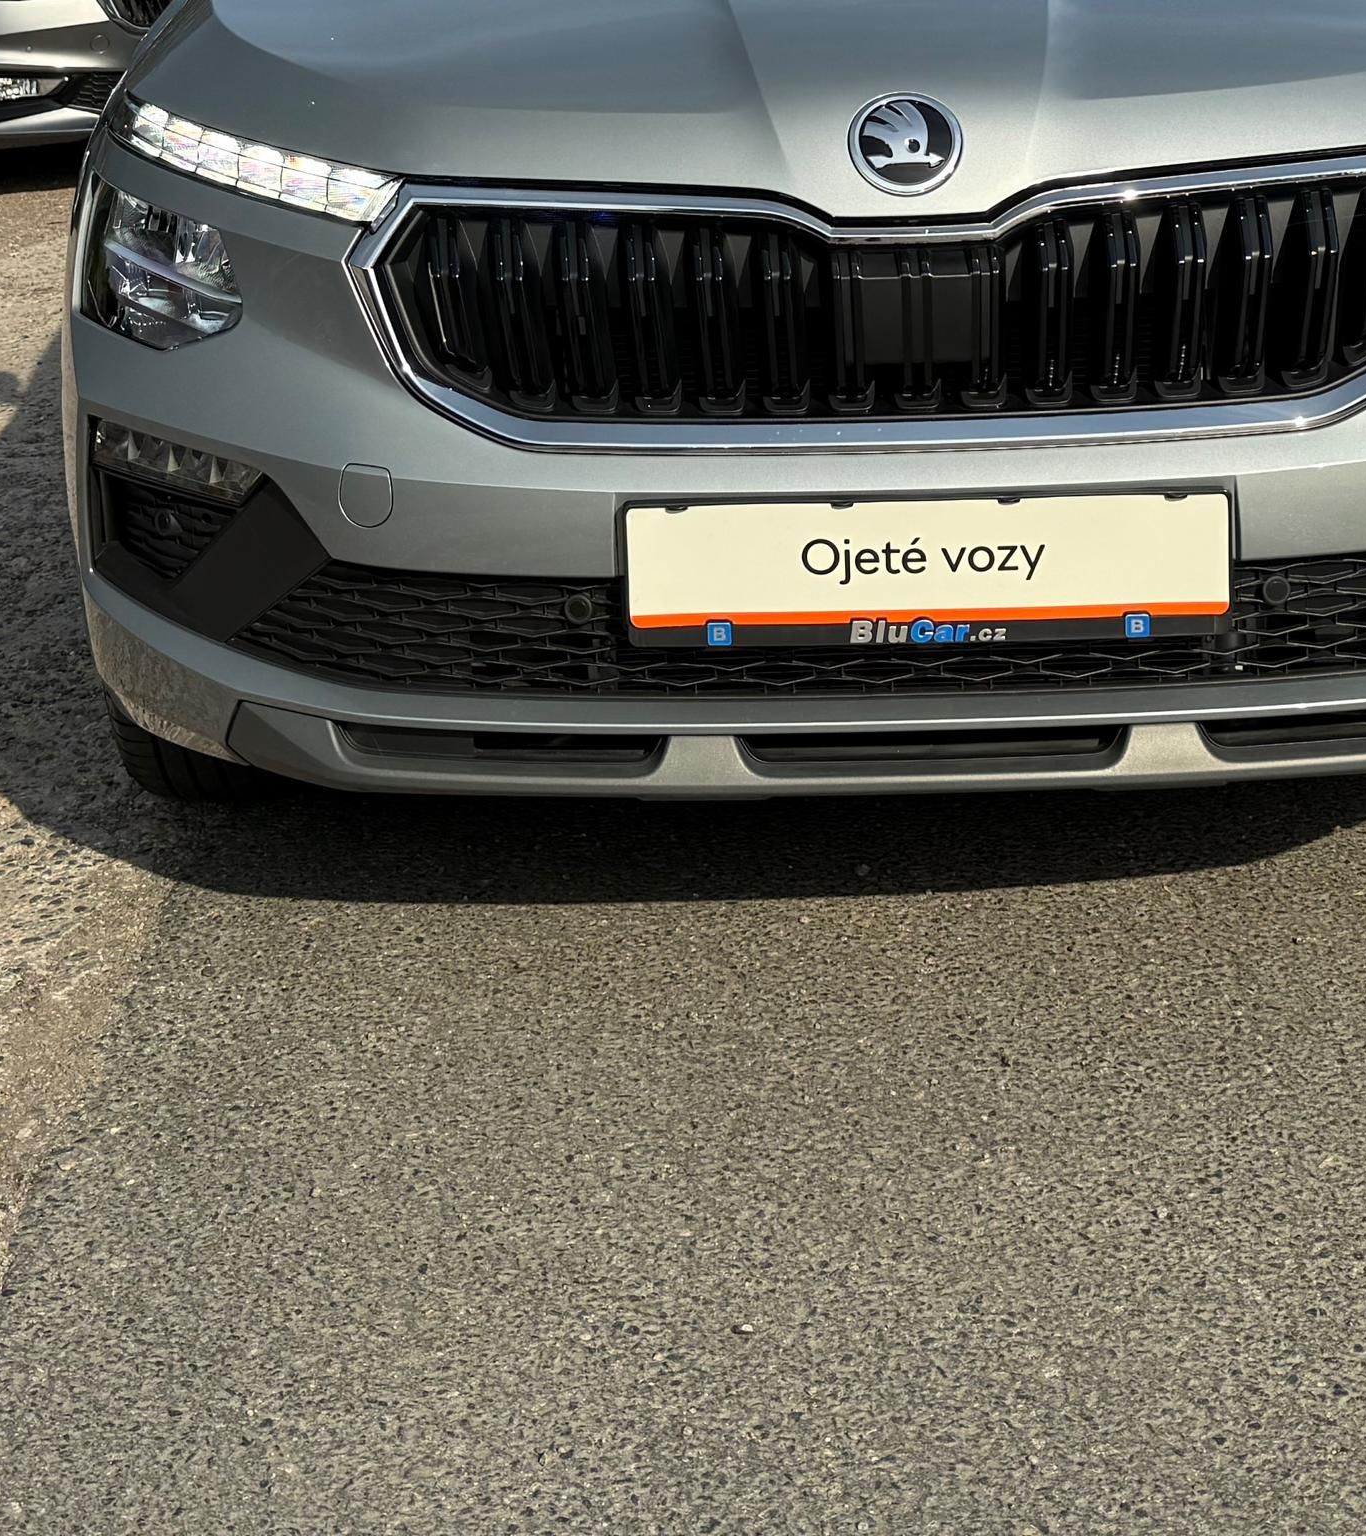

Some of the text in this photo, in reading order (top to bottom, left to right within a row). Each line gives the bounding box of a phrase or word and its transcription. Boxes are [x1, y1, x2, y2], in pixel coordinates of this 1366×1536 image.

[801, 537, 1046, 585] Ojeté vozy
[849, 618, 1007, 645] BluCar.cz
